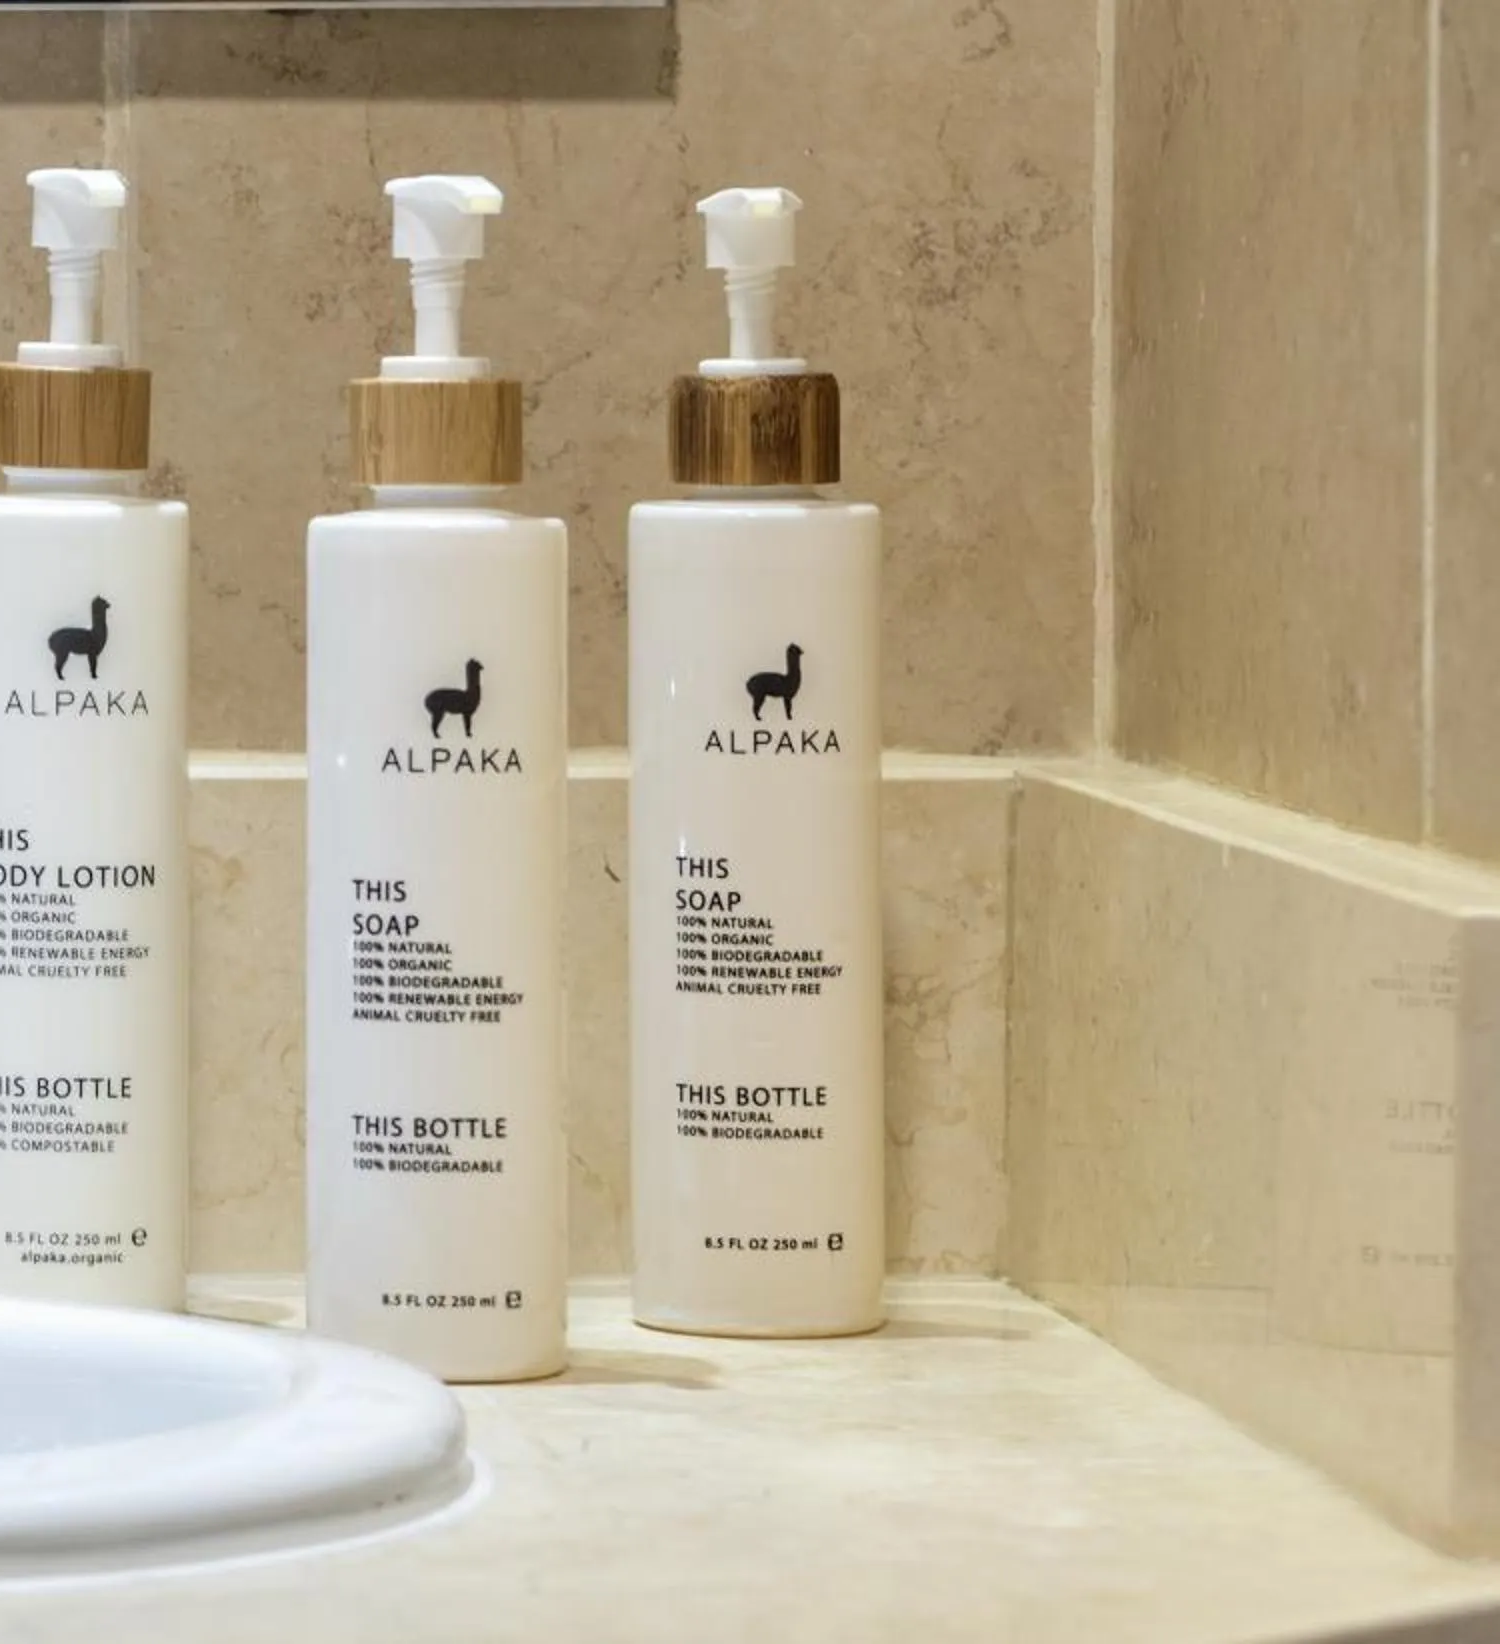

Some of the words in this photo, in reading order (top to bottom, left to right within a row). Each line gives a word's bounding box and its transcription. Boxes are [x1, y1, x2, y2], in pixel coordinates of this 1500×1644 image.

[4, 689, 149, 716] ALPAKA
[705, 730, 840, 754] ALPAKA
[382, 748, 522, 772] ALPAKA
[676, 857, 729, 878] THIS
[57, 864, 156, 887] LOTION
[352, 879, 406, 902] THIS
[11, 892, 76, 906] NATURAL
[676, 890, 741, 911] SOAP
[11, 911, 76, 924] ORGANIC
[677, 916, 706, 927] 100%
[711, 917, 773, 929] NATURAL
[352, 914, 419, 936] SOAP
[11, 928, 129, 942] BIODEGRADABLE
[677, 932, 706, 943] 100%
[711, 933, 773, 945] ORGANIC
[11, 945, 96, 959] RENEWABLE
[101, 946, 149, 959] ENERGY
[353, 941, 384, 953] 100%
[388, 942, 452, 954] NATURAL
[677, 948, 706, 959] 100%
[711, 950, 823, 962] BIODEGRADABLE
[28, 964, 90, 977] CRUELTY
[96, 965, 126, 977] FREE
[353, 958, 384, 970] 100%
[388, 959, 452, 971] ORGANIC
[677, 964, 706, 976] 100%
[711, 966, 792, 978] RENEWABLE
[797, 966, 842, 978] ENERGY
[353, 975, 384, 987] 100%
[388, 976, 503, 989] BIODEGRADABLE
[676, 980, 723, 994] ANIMAL
[728, 983, 786, 995] CRUELTY
[792, 984, 821, 995] FREE
[353, 992, 384, 1004] 100%
[388, 992, 471, 1005] RENEWABLE
[476, 993, 523, 1005] ENERGY
[352, 1009, 400, 1021] ANIMAL
[405, 1010, 465, 1022] CRUELTY
[471, 1011, 500, 1022] FREE
[37, 1077, 132, 1099] BOTTLE
[676, 1083, 725, 1105] THIS
[737, 1087, 827, 1107] BOTTLE
[12, 1103, 75, 1116] NATURAL
[677, 1109, 707, 1120] 100%
[712, 1111, 774, 1123] NATURAL
[12, 1121, 129, 1134] BIODEGRADABLE
[352, 1115, 403, 1137] THIS
[414, 1118, 507, 1139] BOTTLE
[677, 1126, 707, 1136] 100%
[712, 1128, 824, 1140] BIODEGRADABLE
[12, 1138, 115, 1153] COMPOSTABLE
[353, 1142, 384, 1153] 100%
[389, 1143, 451, 1155] NATURAL
[353, 1159, 384, 1170] 100%
[389, 1160, 503, 1173] BIODEGRADABLE
[30, 1233, 43, 1245] FL
[49, 1233, 68, 1245] OZ
[75, 1234, 100, 1245] 250
[105, 1232, 121, 1245] ml
[729, 1238, 744, 1249] FL
[749, 1238, 768, 1250] OZ
[773, 1239, 797, 1250] 250
[802, 1238, 817, 1249] ml
[21, 1251, 124, 1266] alpaka.organic
[406, 1295, 421, 1307] FL
[427, 1295, 445, 1307] OZ
[452, 1296, 475, 1307] 250
[480, 1295, 495, 1307] ml
